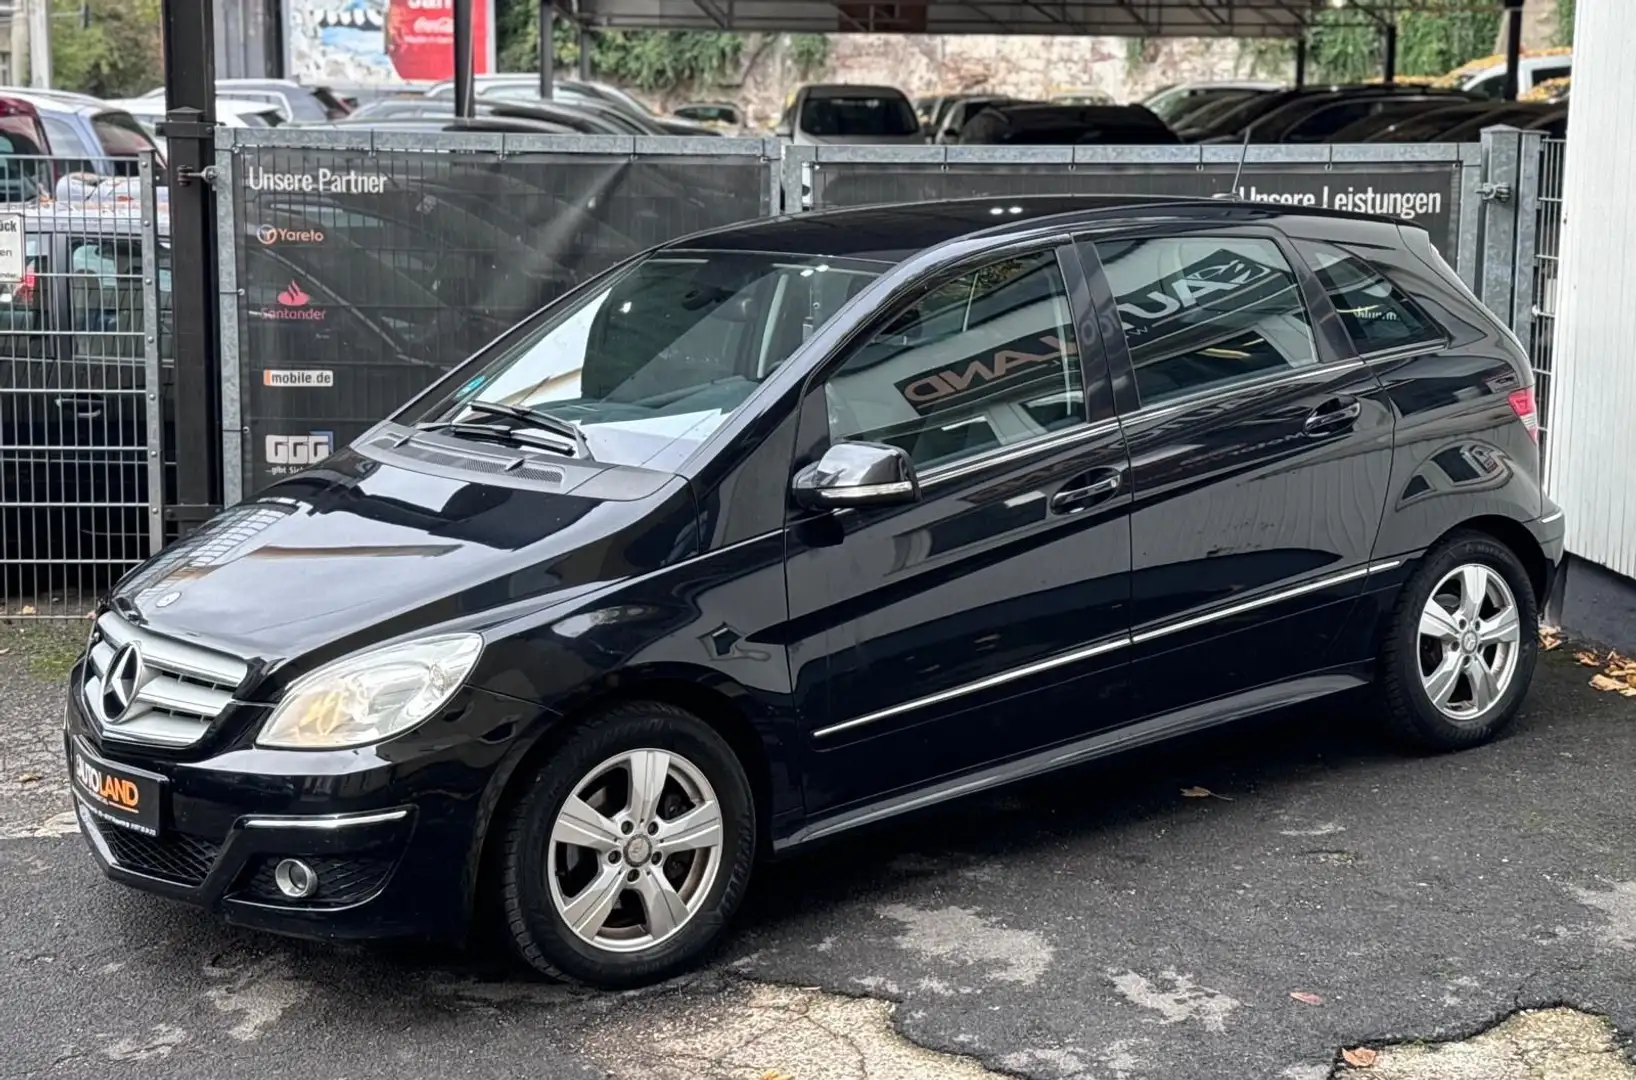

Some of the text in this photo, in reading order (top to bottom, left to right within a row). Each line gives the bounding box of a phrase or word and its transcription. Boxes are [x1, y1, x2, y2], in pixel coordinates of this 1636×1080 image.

[248, 166, 387, 194] Unsere Partner
[1323, 186, 1441, 219] Leistungen
[278, 228, 324, 242] Yareto
[261, 307, 326, 320] Santander
[265, 434, 329, 465] GGG
[76, 753, 139, 806] AUTOLAND
